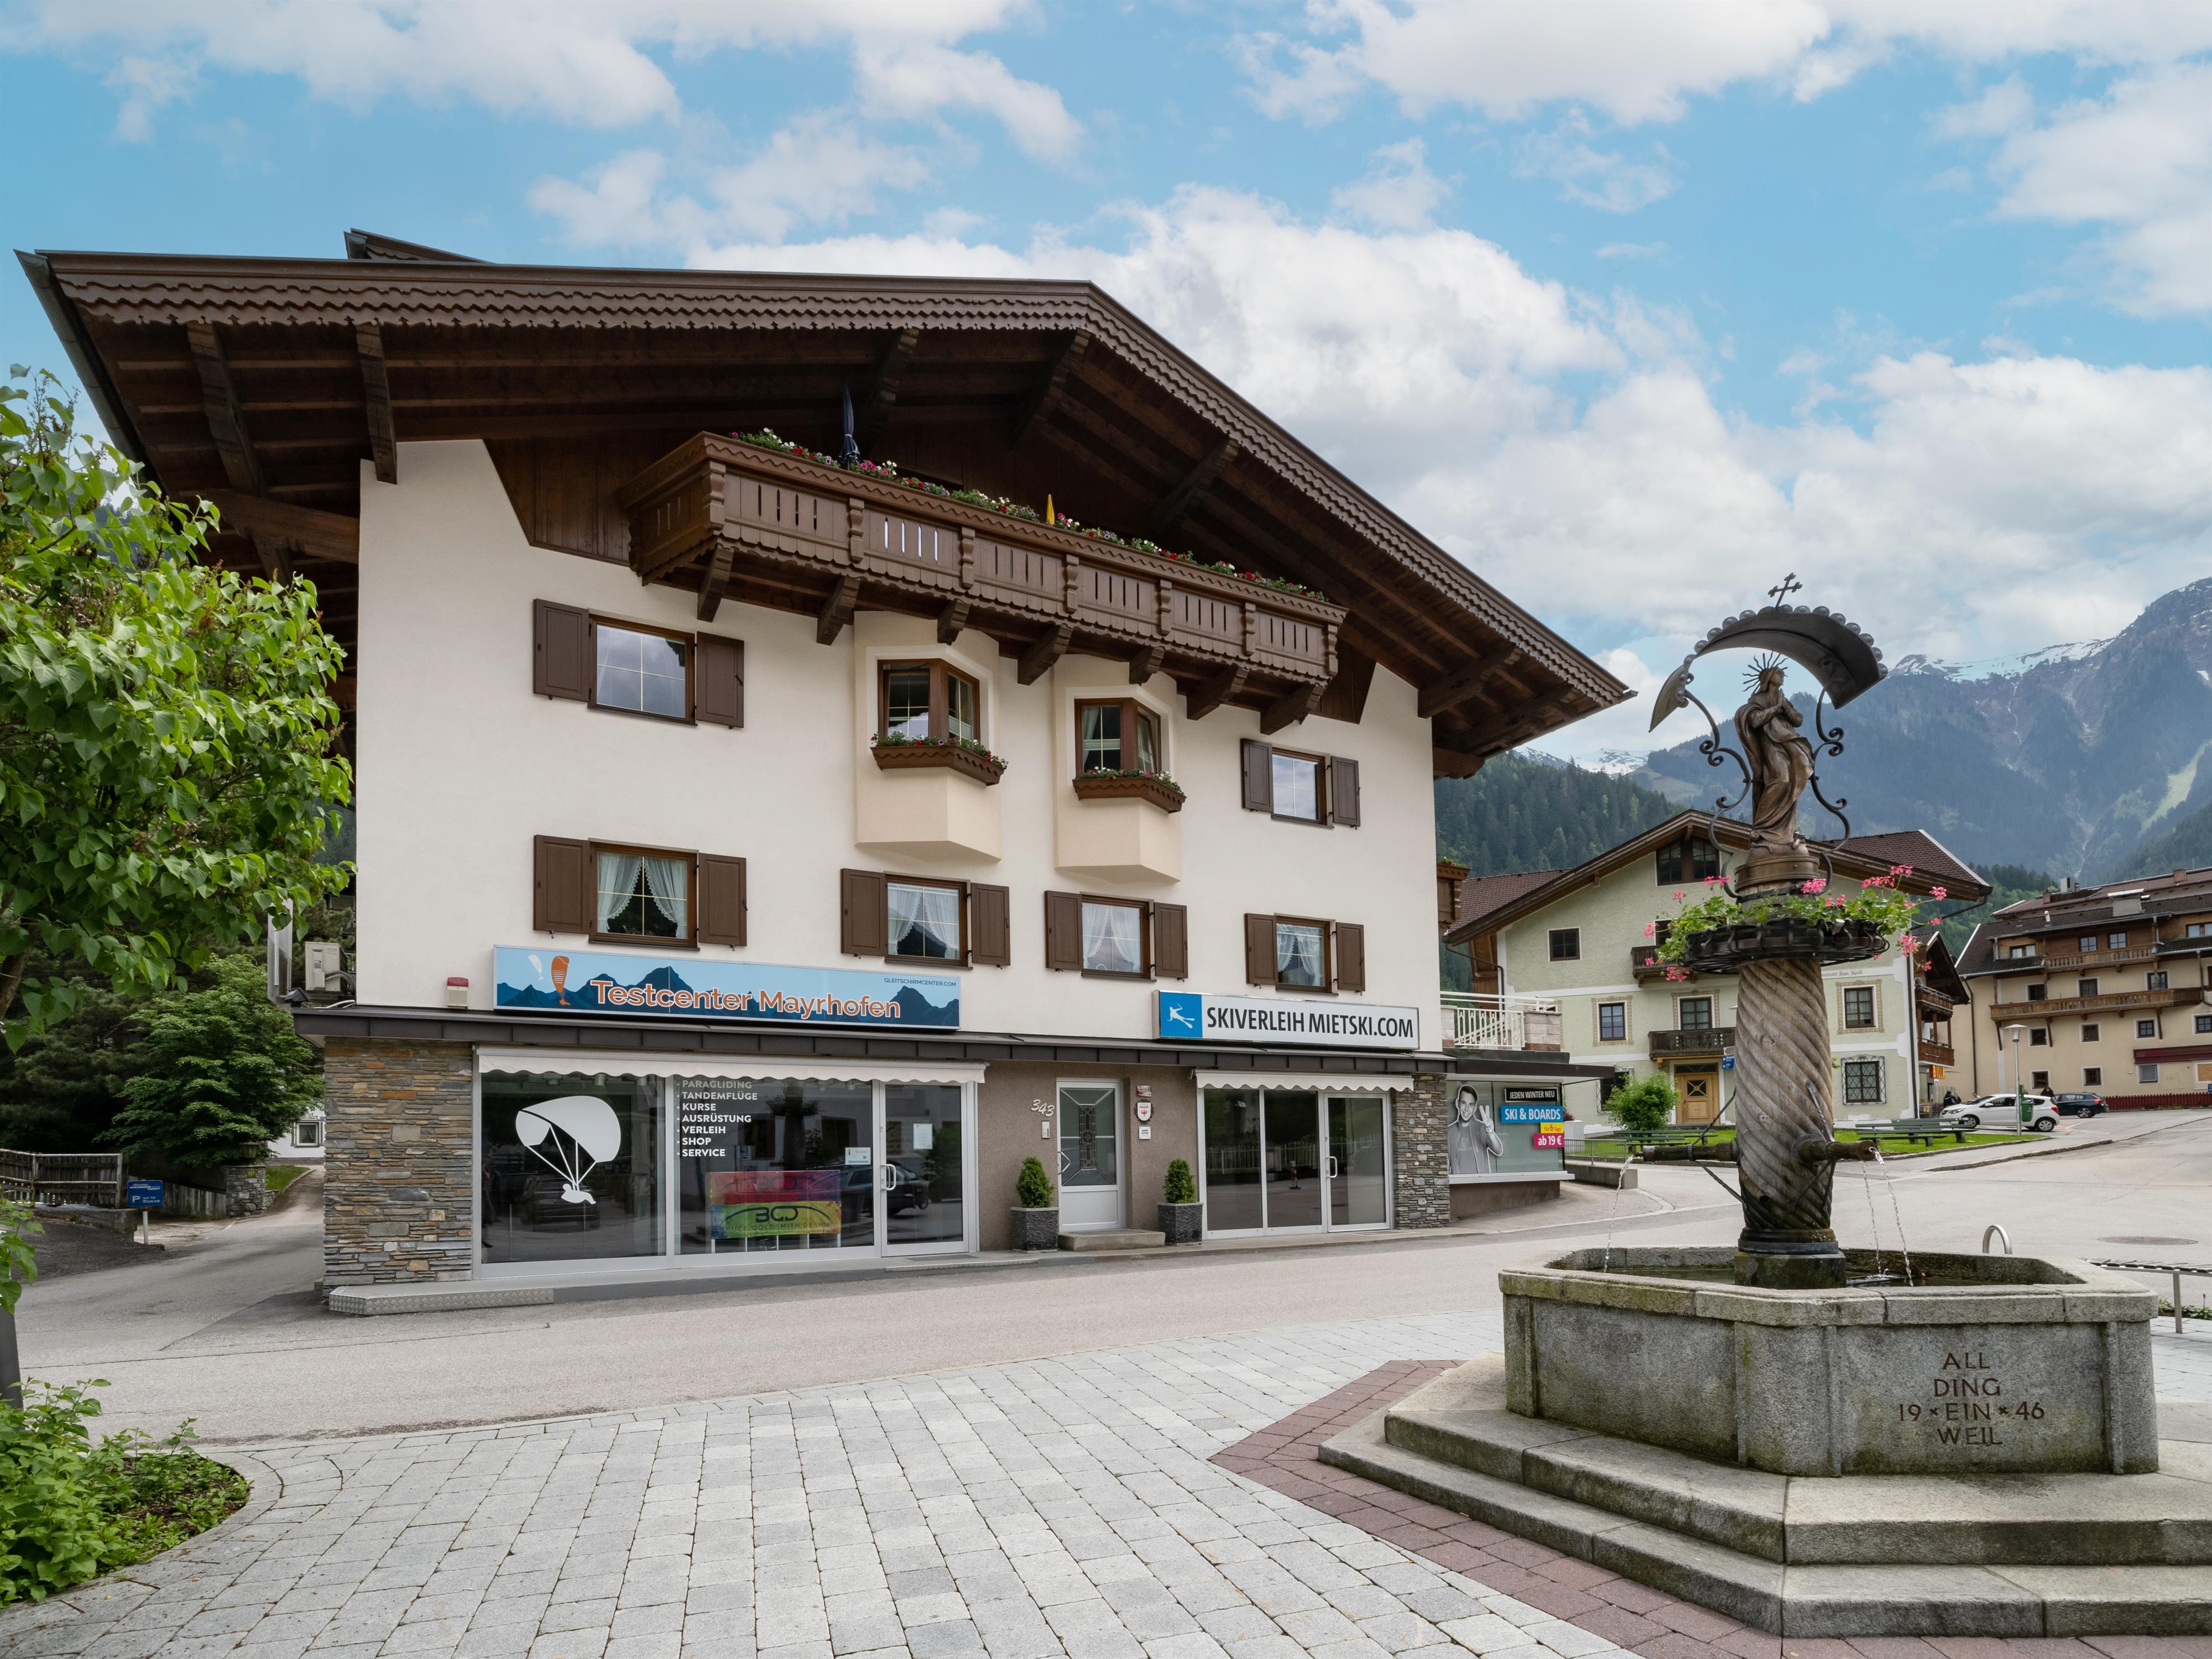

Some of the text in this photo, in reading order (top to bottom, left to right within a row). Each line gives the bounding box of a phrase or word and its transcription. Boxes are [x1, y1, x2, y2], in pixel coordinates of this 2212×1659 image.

[884, 978, 956, 987] GLEITSCHIRMCENTER.COM
[590, 980, 901, 1019] Testcenter Mayrhofen
[1207, 1007, 1413, 1038] SKIVERLEIH MIETSKI.COM
[682, 1080, 752, 1088] PARAGLIDING
[682, 1091, 758, 1100] TANDEMFLÜGE
[682, 1103, 716, 1111] KURSE
[1031, 1099, 1055, 1117] 343
[682, 1113, 752, 1123] AUSRÜSTUNG
[1505, 1108, 1561, 1120] SKI & BOARDS
[1538, 1135, 1562, 1146] ab 19 €
[682, 1149, 726, 1157] SERVICE
[1943, 1353, 1990, 1370] ALL
[1934, 1378, 2000, 1397] DING
[1899, 1401, 2044, 1421] 19 EIN 46
[1937, 1427, 2002, 1446] WEIL
